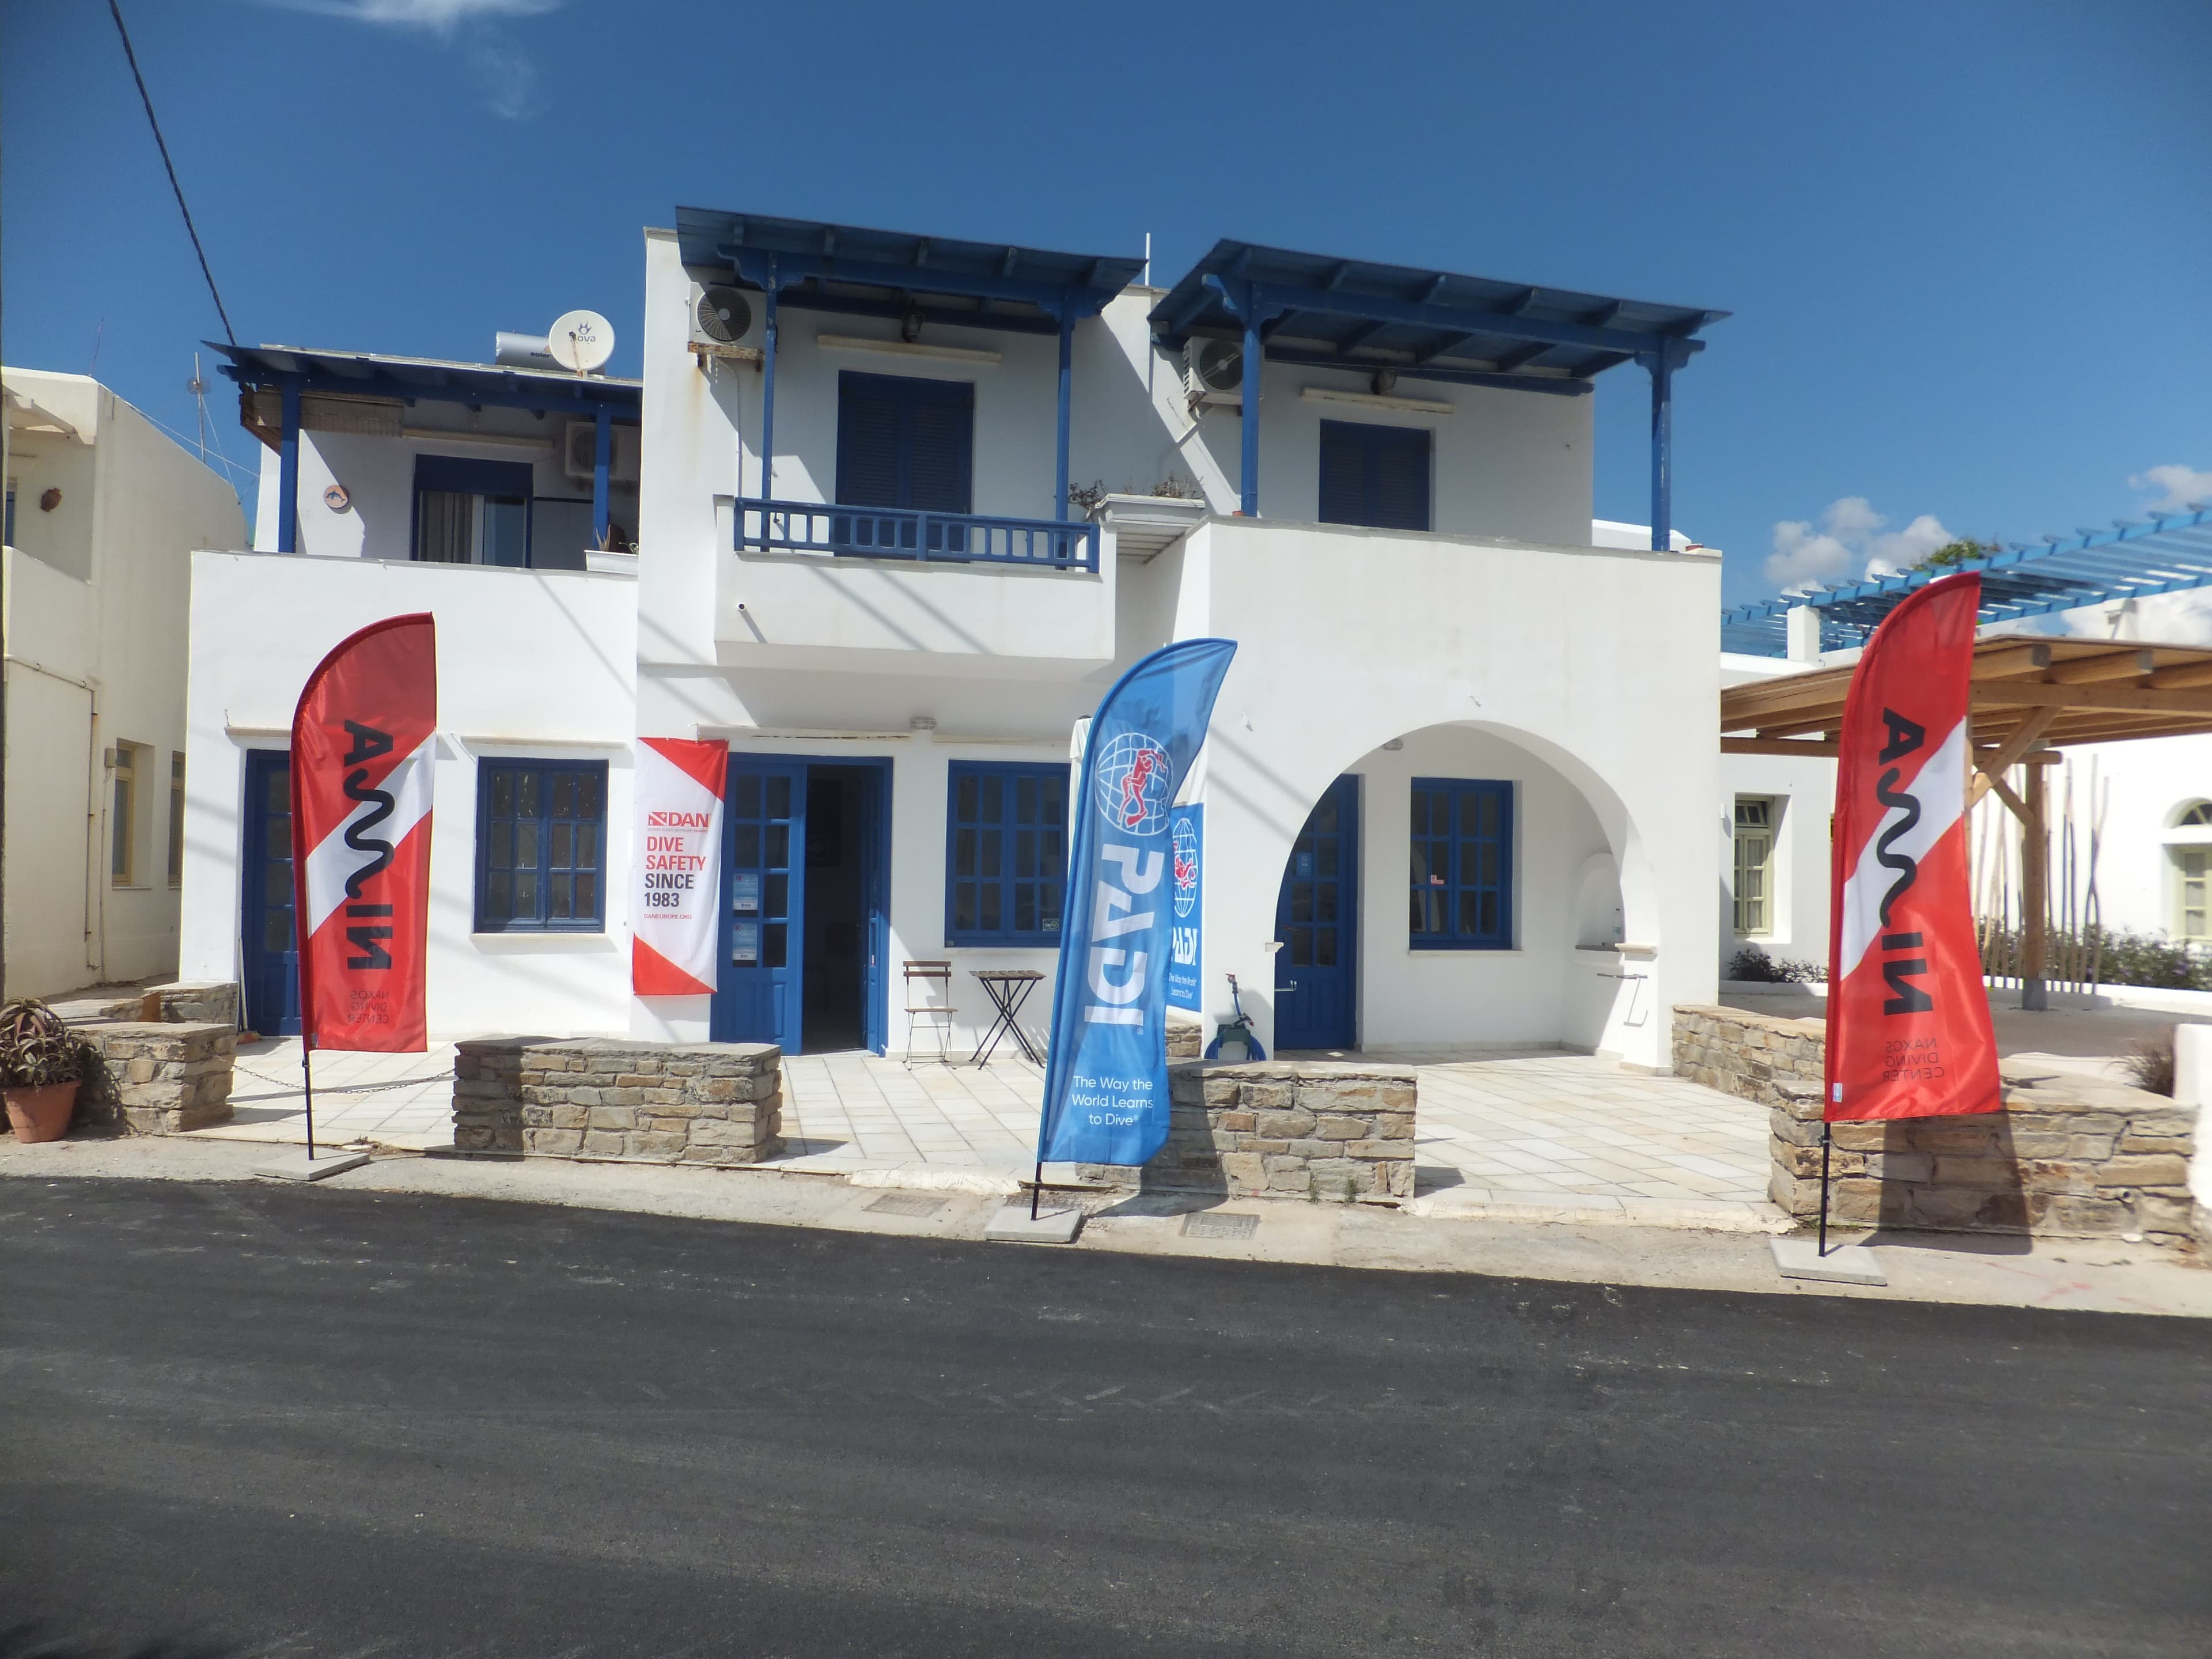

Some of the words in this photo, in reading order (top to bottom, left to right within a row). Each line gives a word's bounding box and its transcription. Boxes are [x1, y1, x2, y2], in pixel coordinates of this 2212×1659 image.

[573, 335, 596, 343] ova
[668, 812, 709, 828] DAN
[646, 836, 684, 852] DIVE
[646, 854, 706, 871] SAFETY
[645, 873, 694, 889] SINCE
[644, 892, 680, 907] 1983
[1084, 843, 1165, 1026] PADI
[1073, 1075, 1096, 1088] The
[1100, 1077, 1129, 1093] Way
[1132, 1079, 1153, 1090] the
[1072, 1094, 1108, 1107] World
[1112, 1096, 1154, 1108] Learns
[1089, 1113, 1102, 1124] to
